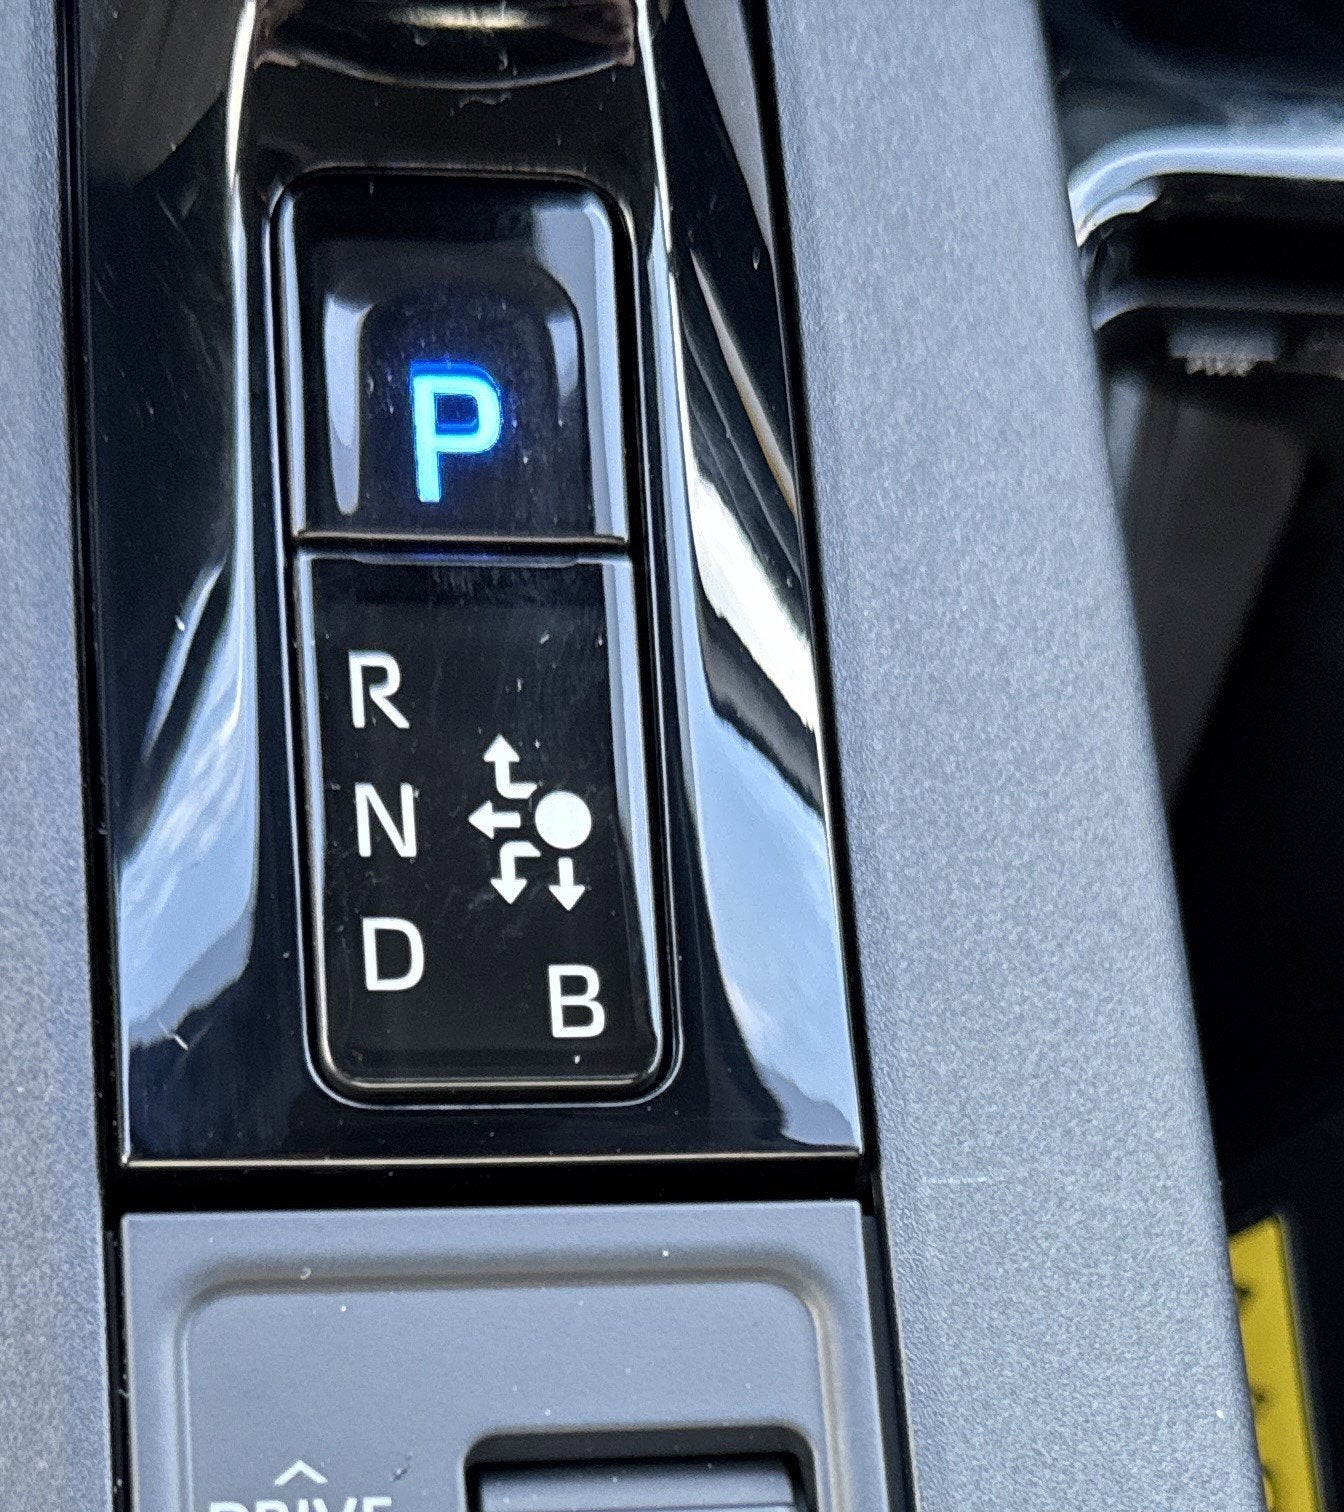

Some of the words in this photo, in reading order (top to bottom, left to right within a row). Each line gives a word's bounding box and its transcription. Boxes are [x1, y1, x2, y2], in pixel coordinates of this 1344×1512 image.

[409, 361, 502, 503] P
[348, 650, 410, 730] R
[354, 781, 419, 858] N
[361, 917, 425, 992] D
[547, 964, 605, 1039] B
